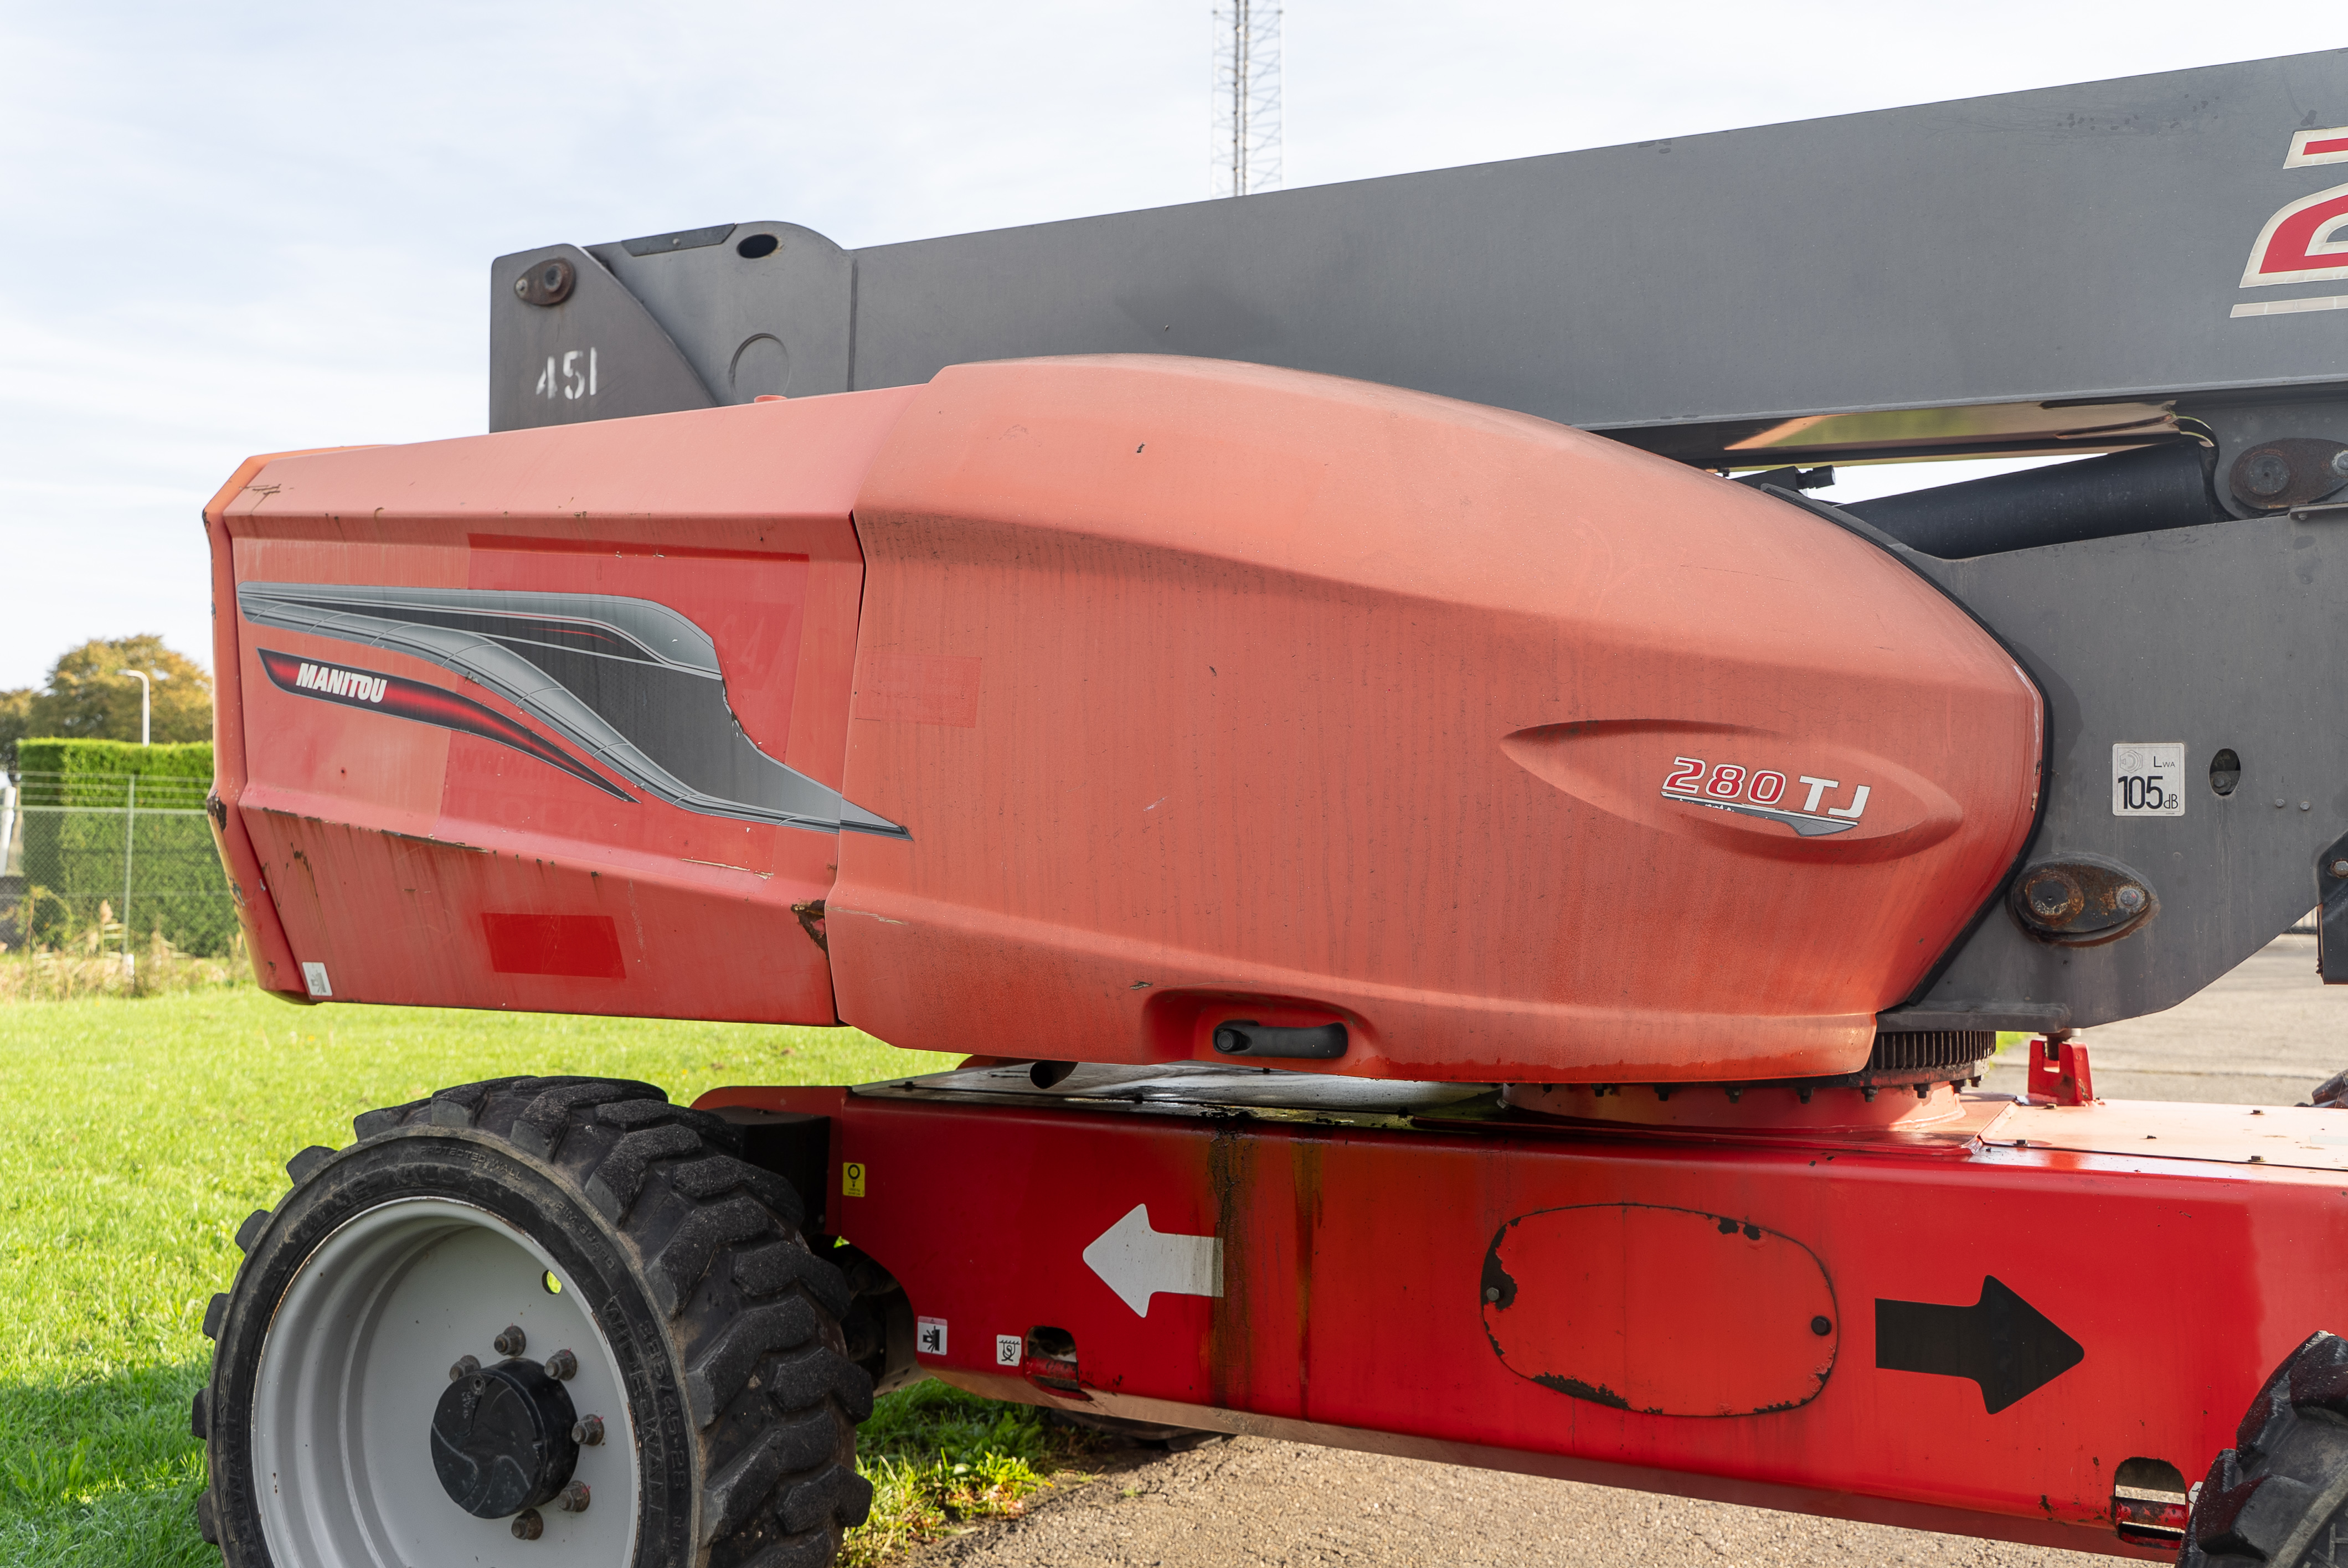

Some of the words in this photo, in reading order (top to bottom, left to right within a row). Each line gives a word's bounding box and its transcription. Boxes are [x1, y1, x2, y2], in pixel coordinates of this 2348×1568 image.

[535, 347, 598, 400] 451
[295, 662, 388, 704] MANITOU
[1661, 756, 1786, 806] 280
[1799, 775, 1871, 818] TJ
[2118, 776, 2164, 809] 105
[2163, 793, 2179, 809] dB
[419, 1145, 486, 1163] PROTECTED
[491, 1158, 522, 1181] WALL
[554, 1200, 579, 1223] RIM
[578, 1224, 616, 1270] GUARD
